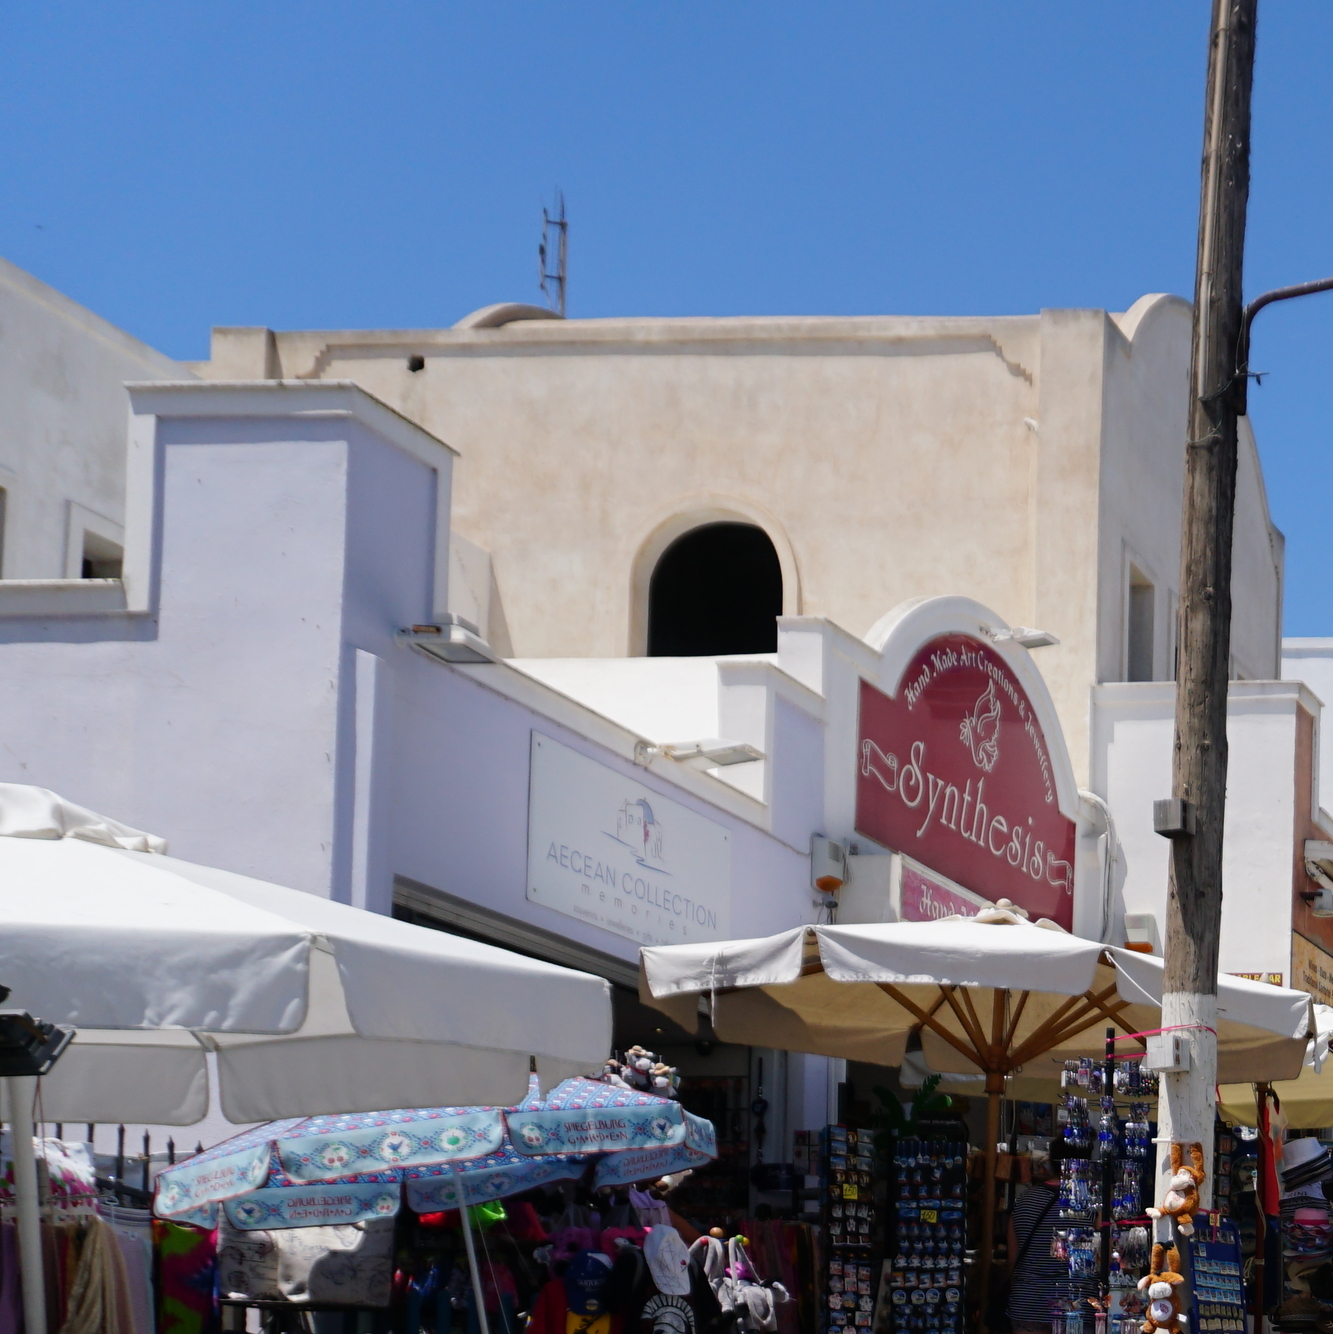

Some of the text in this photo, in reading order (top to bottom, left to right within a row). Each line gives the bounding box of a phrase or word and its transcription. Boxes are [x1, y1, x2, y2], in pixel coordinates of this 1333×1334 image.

[904, 665, 931, 710] Hand
[930, 647, 958, 678] Made
[960, 644, 977, 668] Art
[977, 651, 1020, 706] Creations
[1017, 700, 1026, 719] &
[899, 740, 1044, 880] Synthesis
[581, 882, 688, 936] memories
[621, 872, 717, 931] COLLECTION
[563, 1118, 627, 1133] SPIEGELBURG
